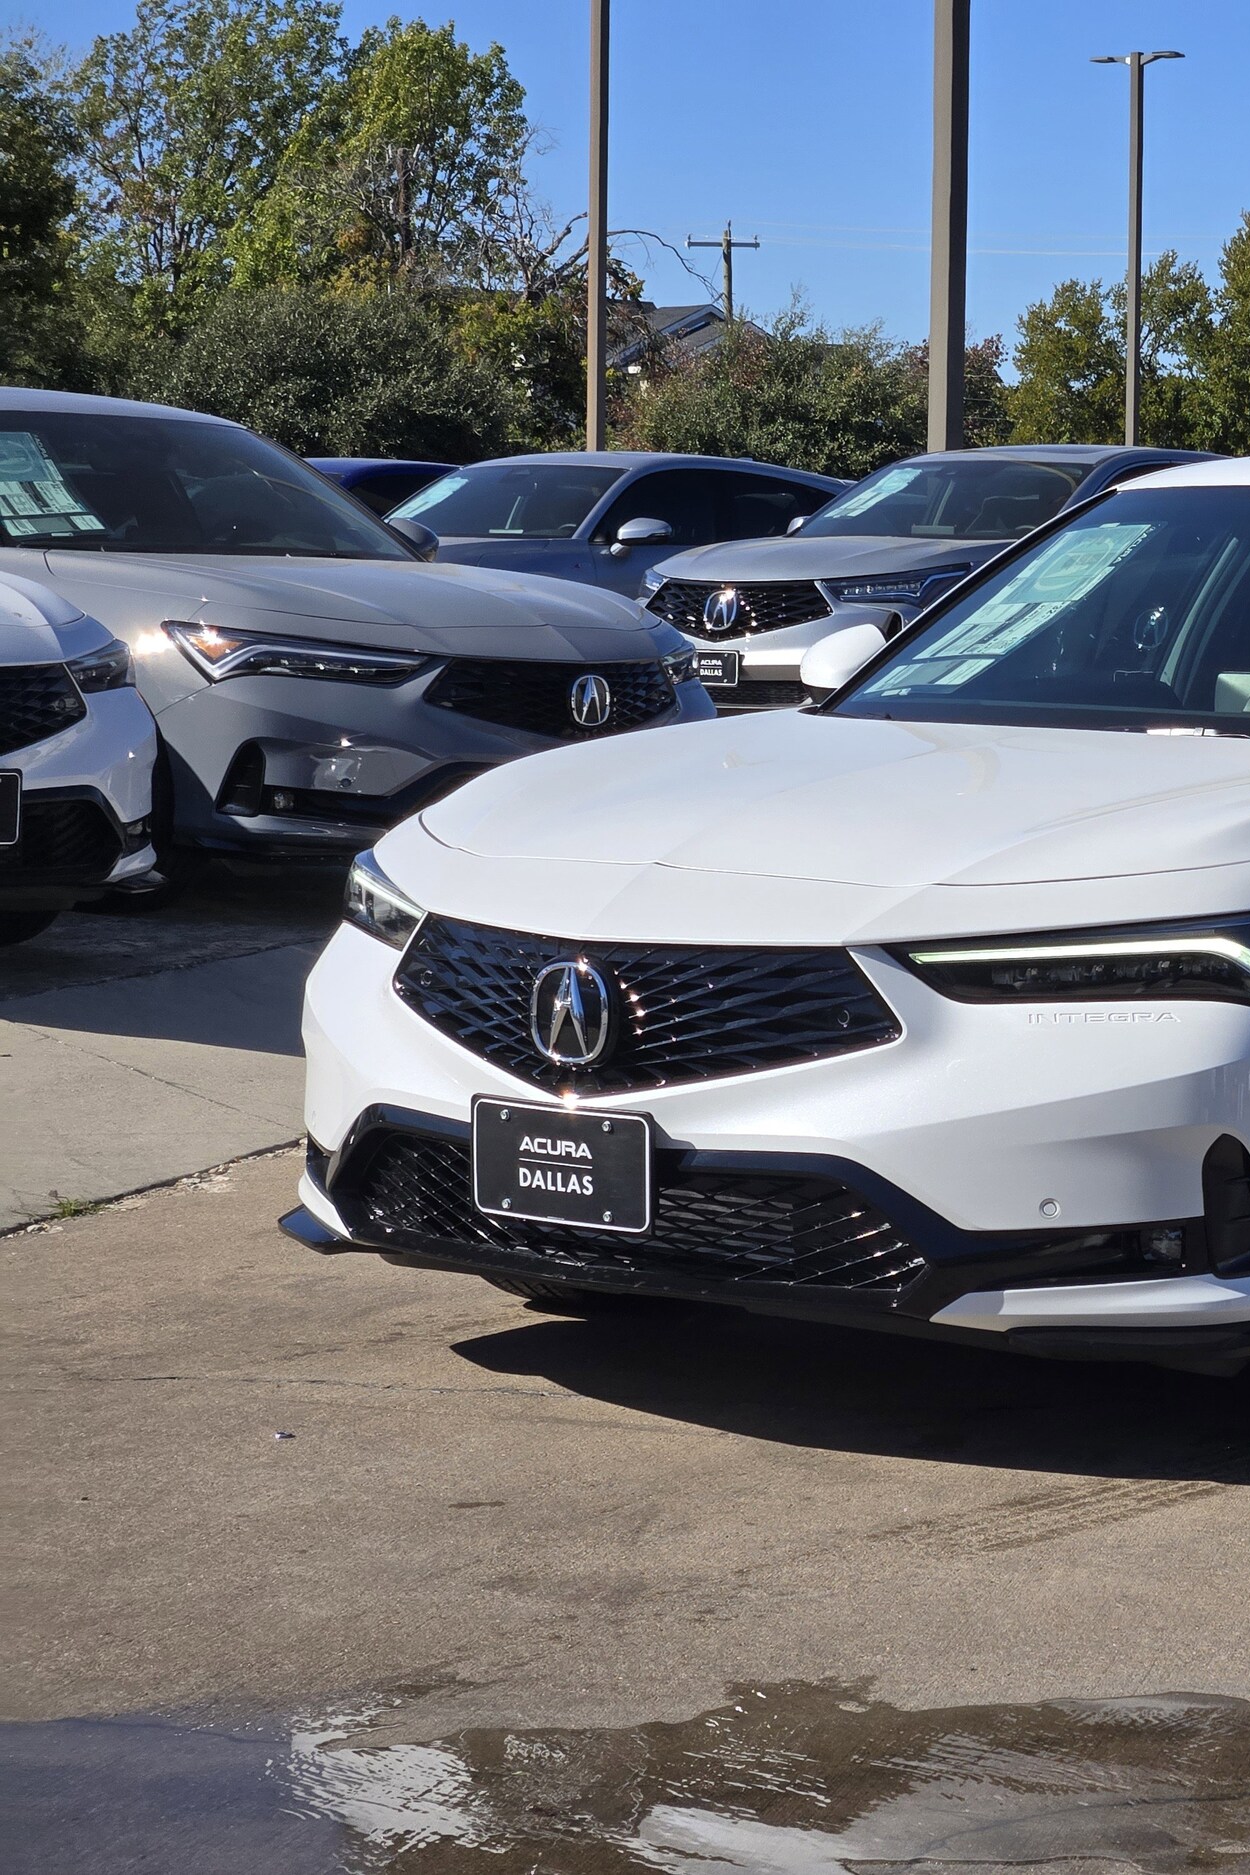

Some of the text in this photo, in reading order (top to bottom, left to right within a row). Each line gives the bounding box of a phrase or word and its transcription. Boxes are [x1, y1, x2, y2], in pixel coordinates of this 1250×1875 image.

[1113, 532, 1147, 565] ACURA
[700, 668, 723, 677] DALLAS
[1028, 1012, 1181, 1024] INTEGRA
[519, 1136, 593, 1159] ACURA
[519, 1167, 594, 1196] DALLAS
